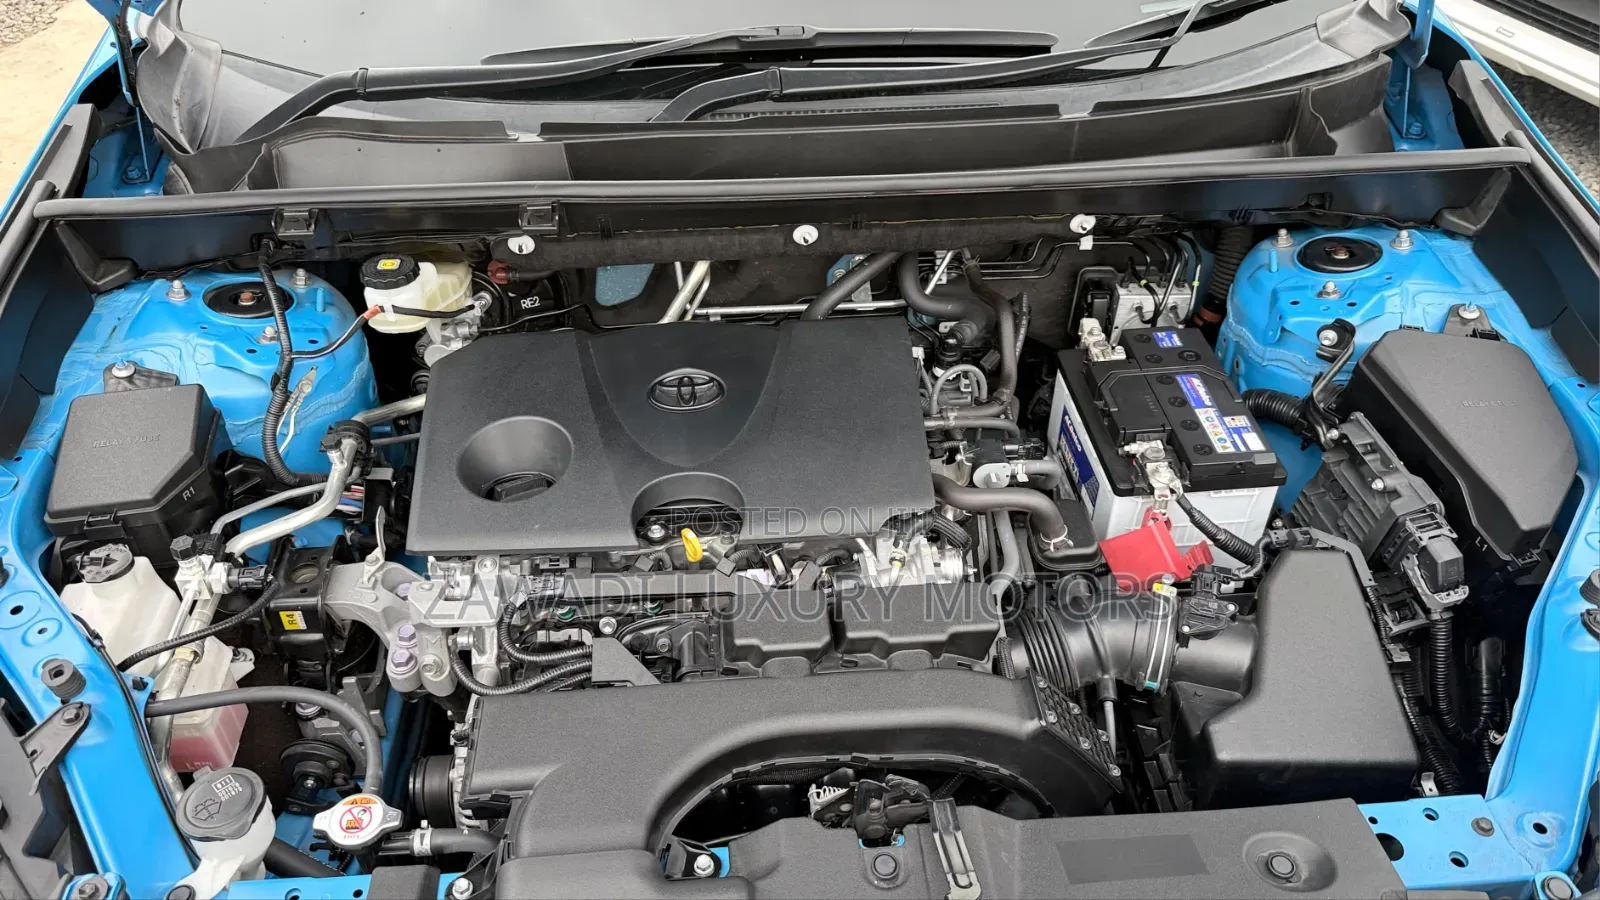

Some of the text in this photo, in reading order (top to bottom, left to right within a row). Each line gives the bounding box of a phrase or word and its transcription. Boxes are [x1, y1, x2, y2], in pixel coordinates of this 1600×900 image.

[520, 296, 541, 310] RE2
[93, 437, 125, 448] RELAY
[182, 486, 196, 501] R1
[1475, 536, 1488, 552] L1
[285, 613, 298, 625] R4
